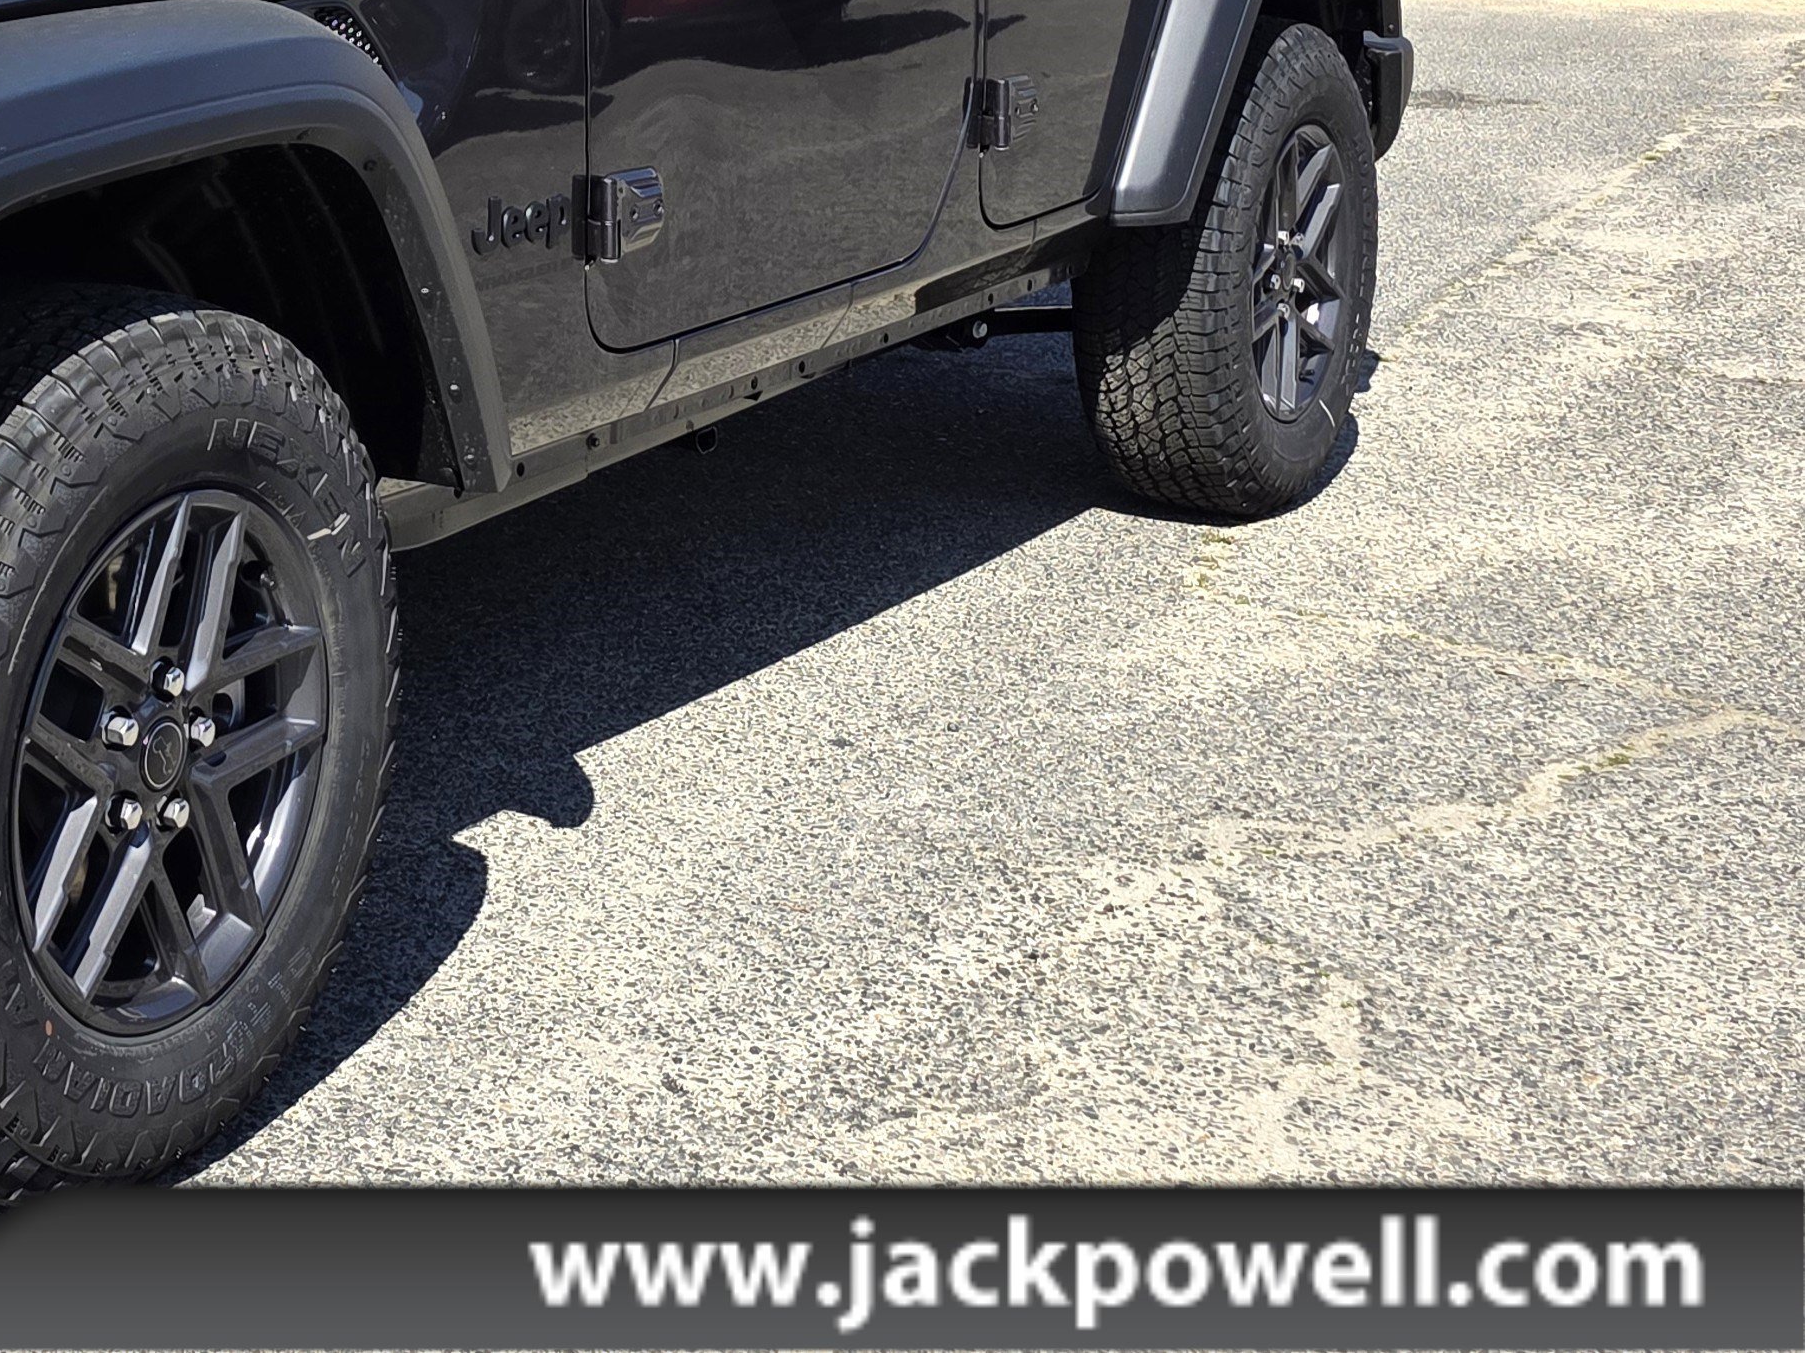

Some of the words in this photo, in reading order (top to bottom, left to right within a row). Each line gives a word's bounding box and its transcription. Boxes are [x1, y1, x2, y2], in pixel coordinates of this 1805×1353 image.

[471, 194, 571, 255] Jeep
[206, 418, 367, 578] NEXEN
[33, 1038, 237, 1118] ROADIAN
